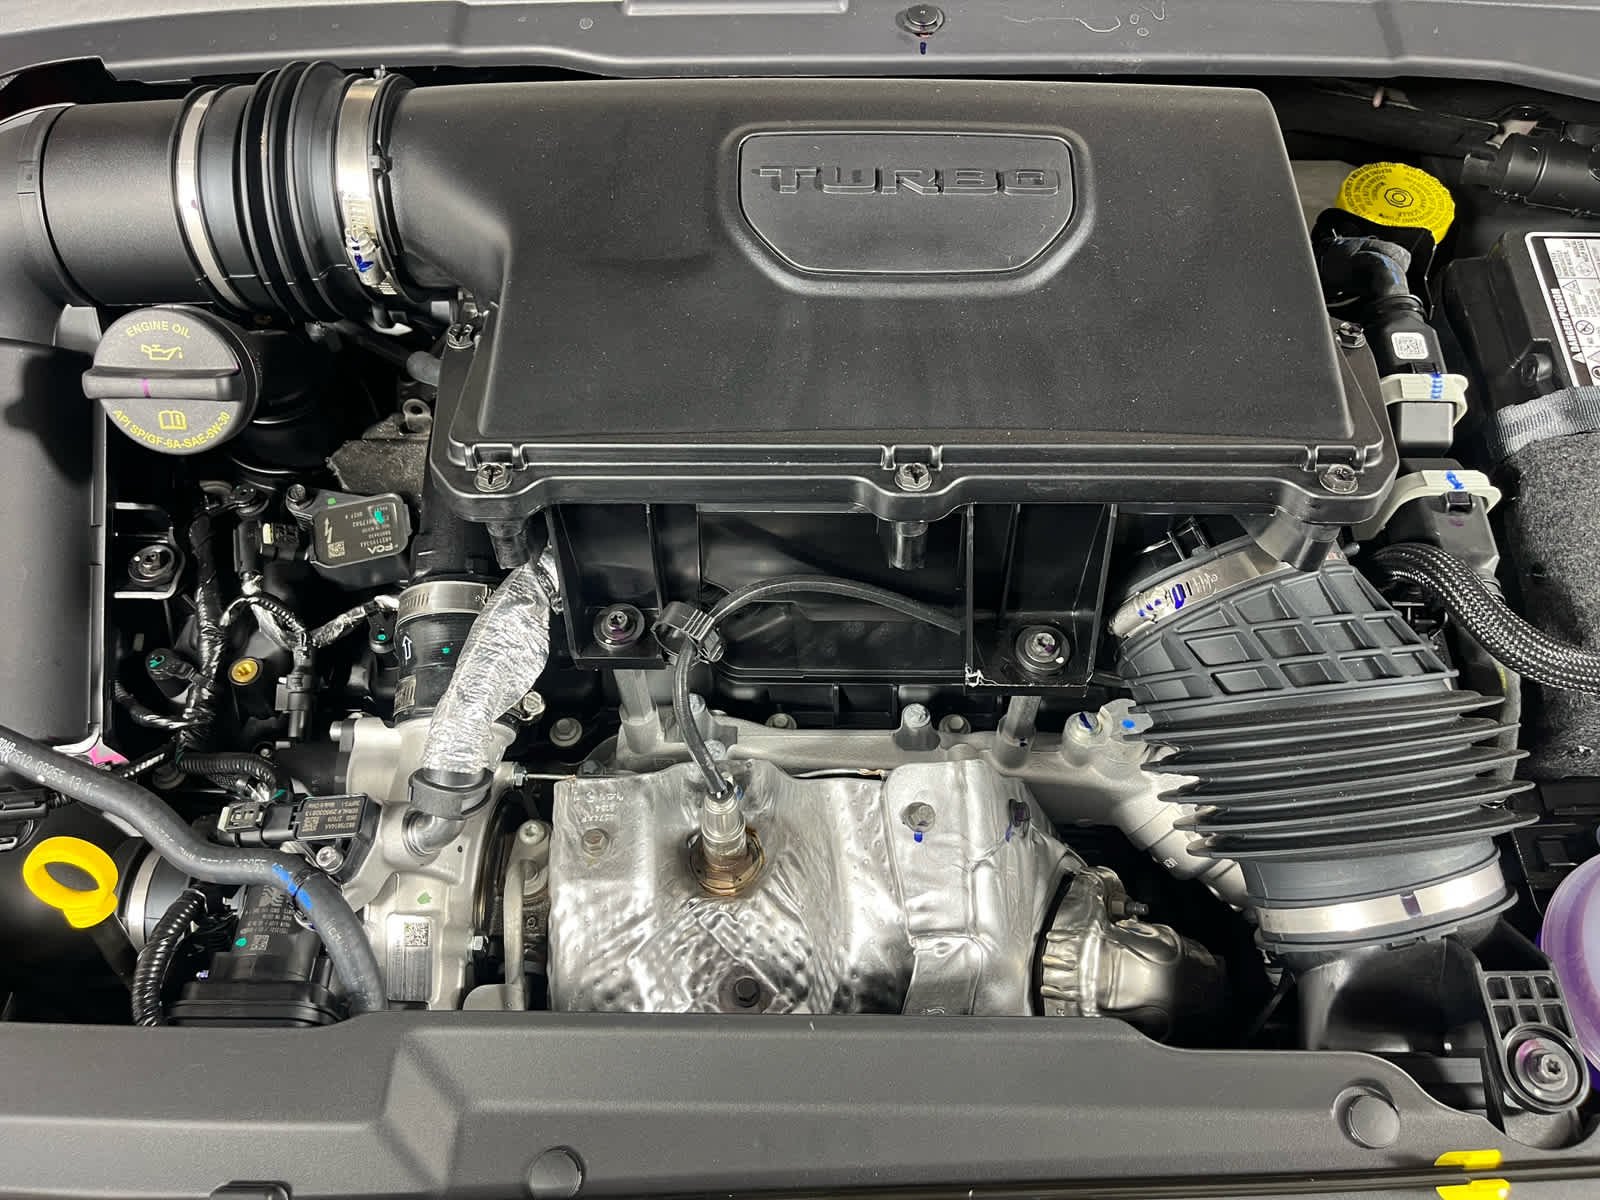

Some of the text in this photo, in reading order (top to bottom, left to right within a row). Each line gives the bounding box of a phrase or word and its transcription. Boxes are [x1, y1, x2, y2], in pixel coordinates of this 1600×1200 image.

[758, 167, 1060, 195] TURBO
[126, 319, 191, 339] ENGINE OIL
[1550, 288, 1582, 353] DANGER/POISON
[112, 409, 129, 428] API
[367, 543, 394, 554] FCA
